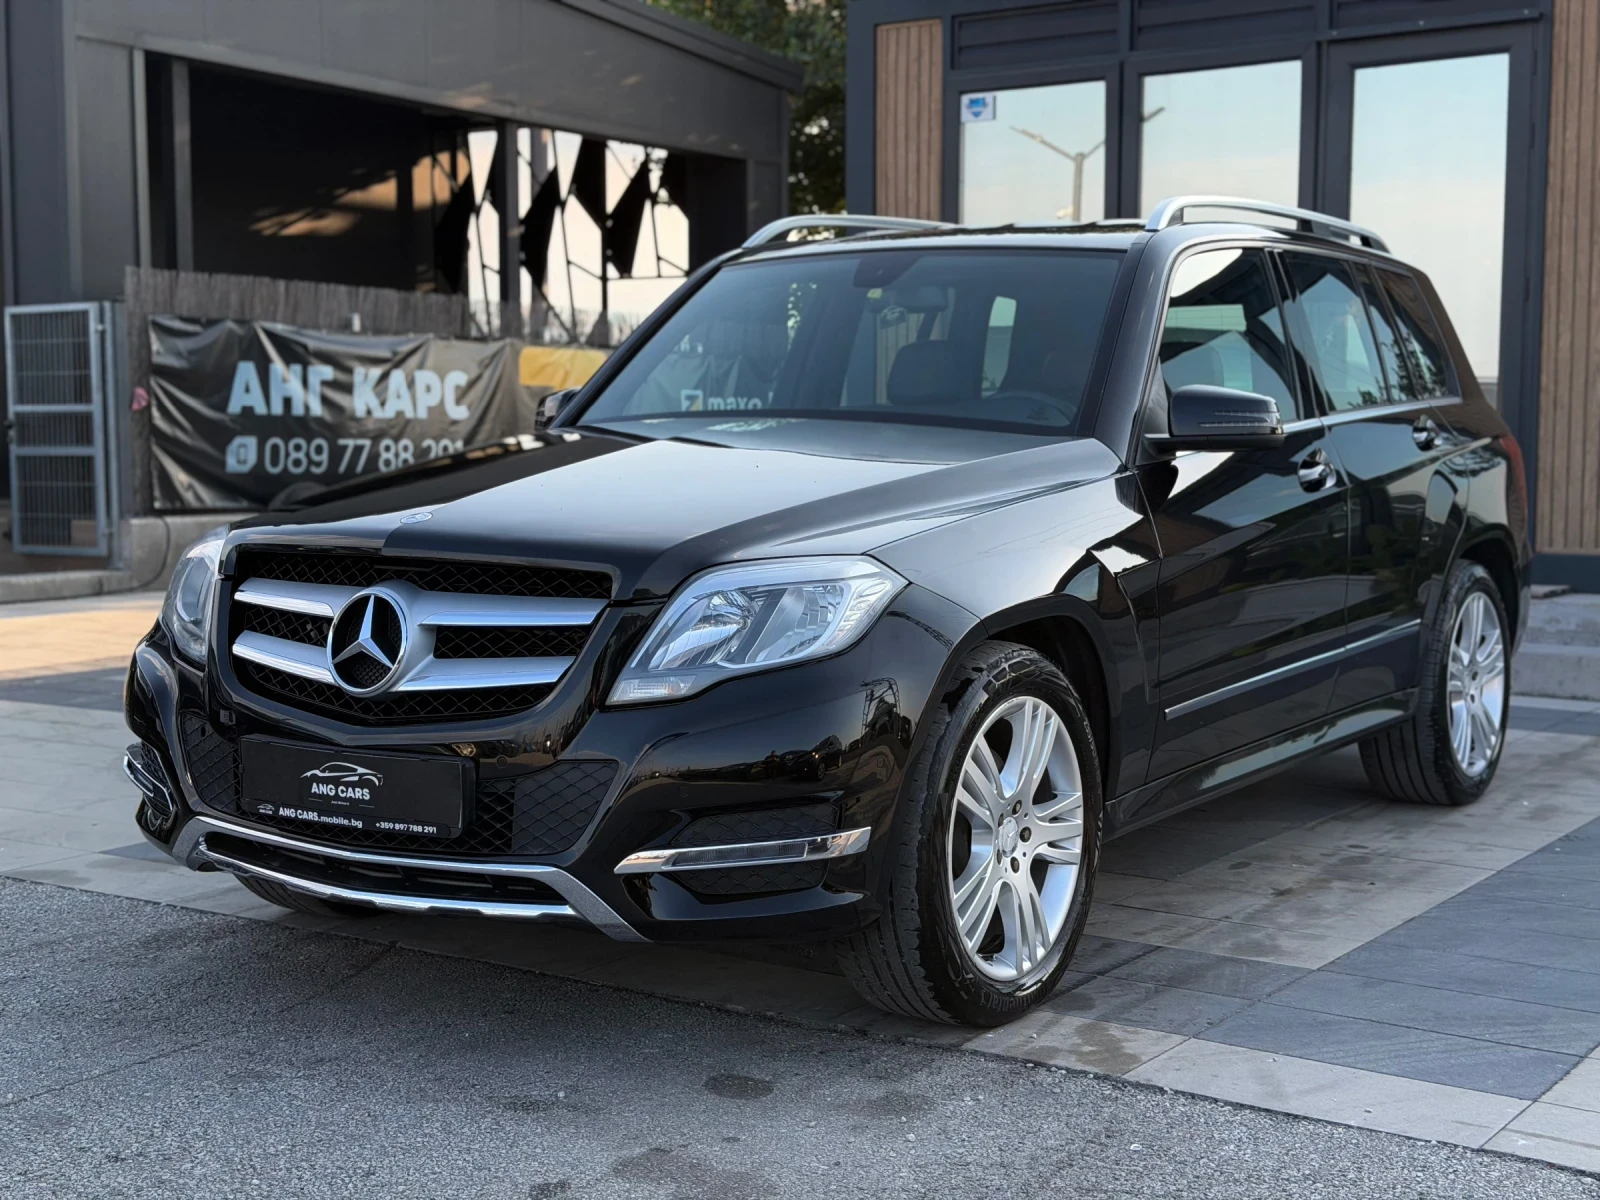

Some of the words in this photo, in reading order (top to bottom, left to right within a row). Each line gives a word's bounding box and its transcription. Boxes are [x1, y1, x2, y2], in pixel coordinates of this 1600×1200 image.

[227, 360, 335, 416] АНГ
[353, 366, 470, 420] КАРС
[264, 437, 329, 474] 089
[337, 438, 372, 474] 77
[378, 438, 414, 473] 88
[311, 782, 336, 796] ANG
[338, 786, 371, 800] CARS
[278, 806, 296, 818] ANG
[296, 810, 363, 828] CARS.mobile.bg
[375, 821, 394, 829] +359
[394, 823, 408, 831] 897
[408, 824, 423, 832] 788
[423, 826, 437, 834] 291
